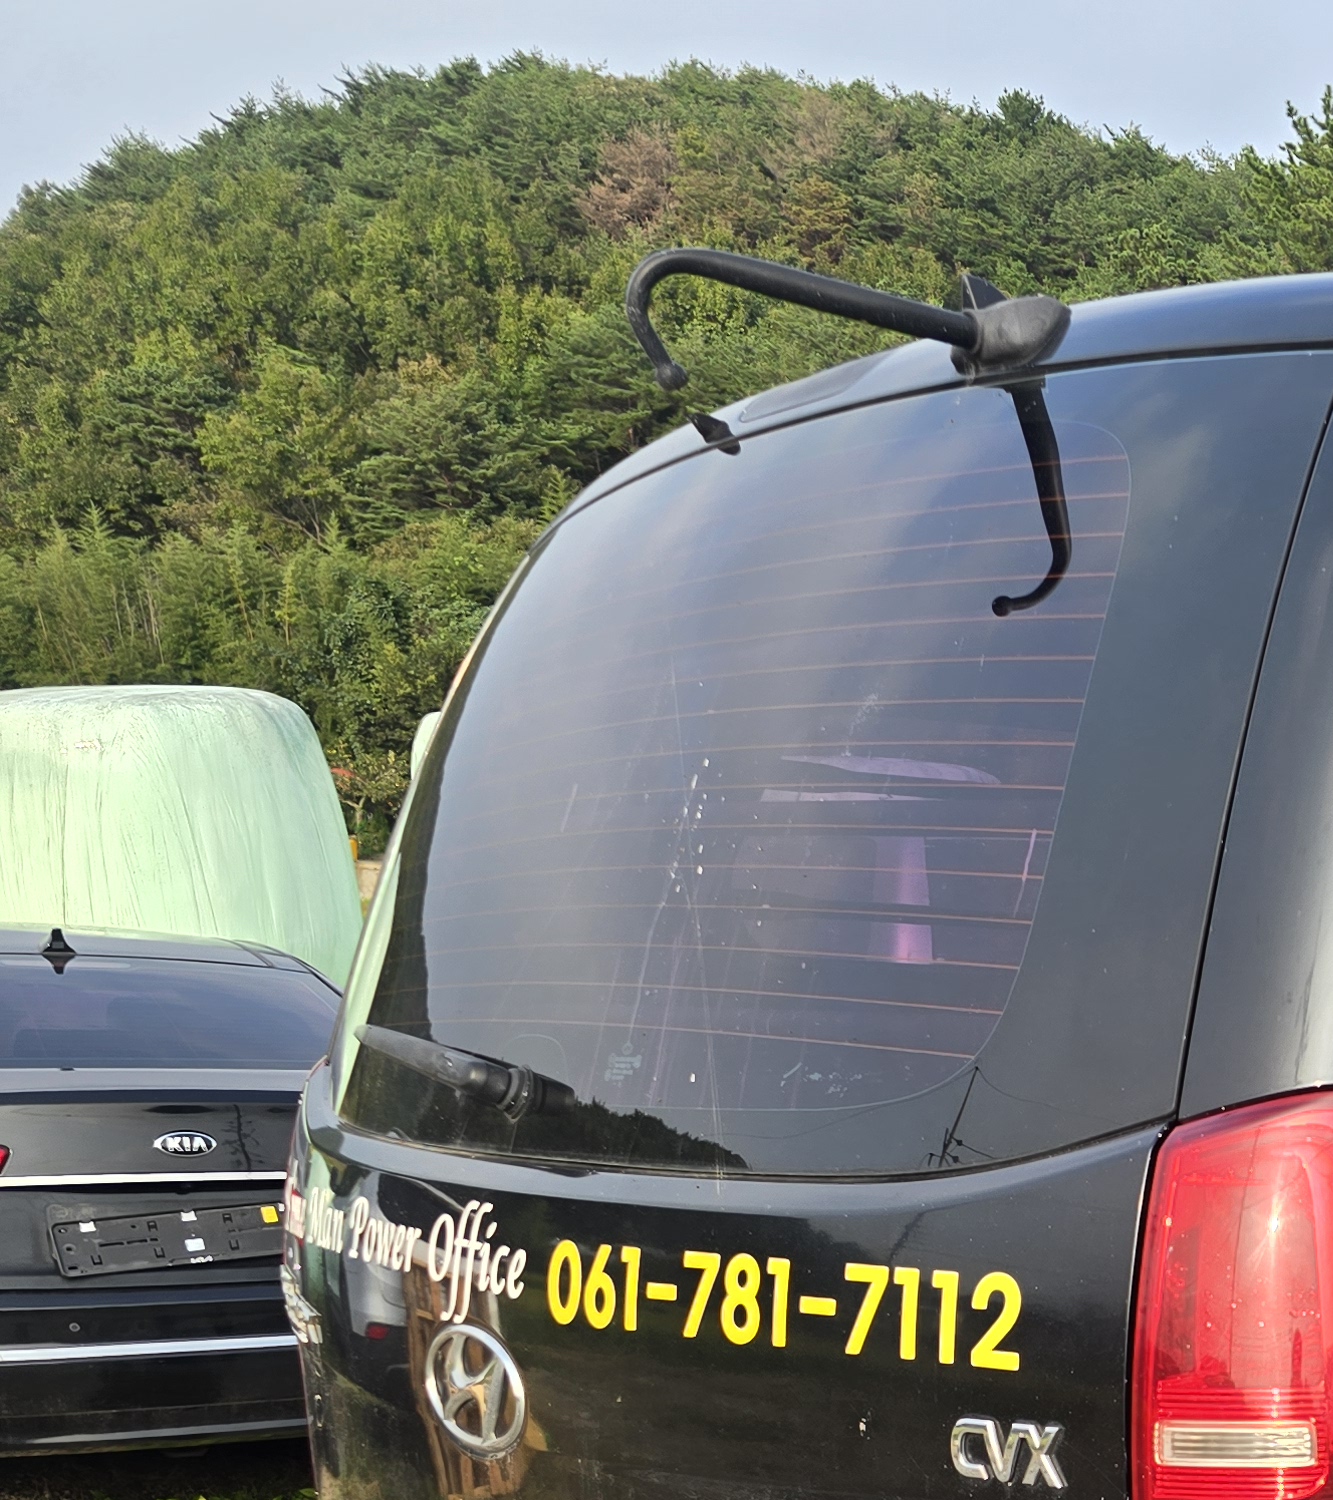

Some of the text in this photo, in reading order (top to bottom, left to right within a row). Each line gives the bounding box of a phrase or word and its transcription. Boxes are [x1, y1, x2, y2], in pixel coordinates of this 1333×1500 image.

[165, 1136, 209, 1152] KIA
[306, 1187, 344, 1254] Man
[349, 1196, 422, 1273] Power
[427, 1200, 527, 1324] Office
[547, 1240, 1022, 1371] 061-781-7112
[950, 1415, 1066, 1488] CVX
